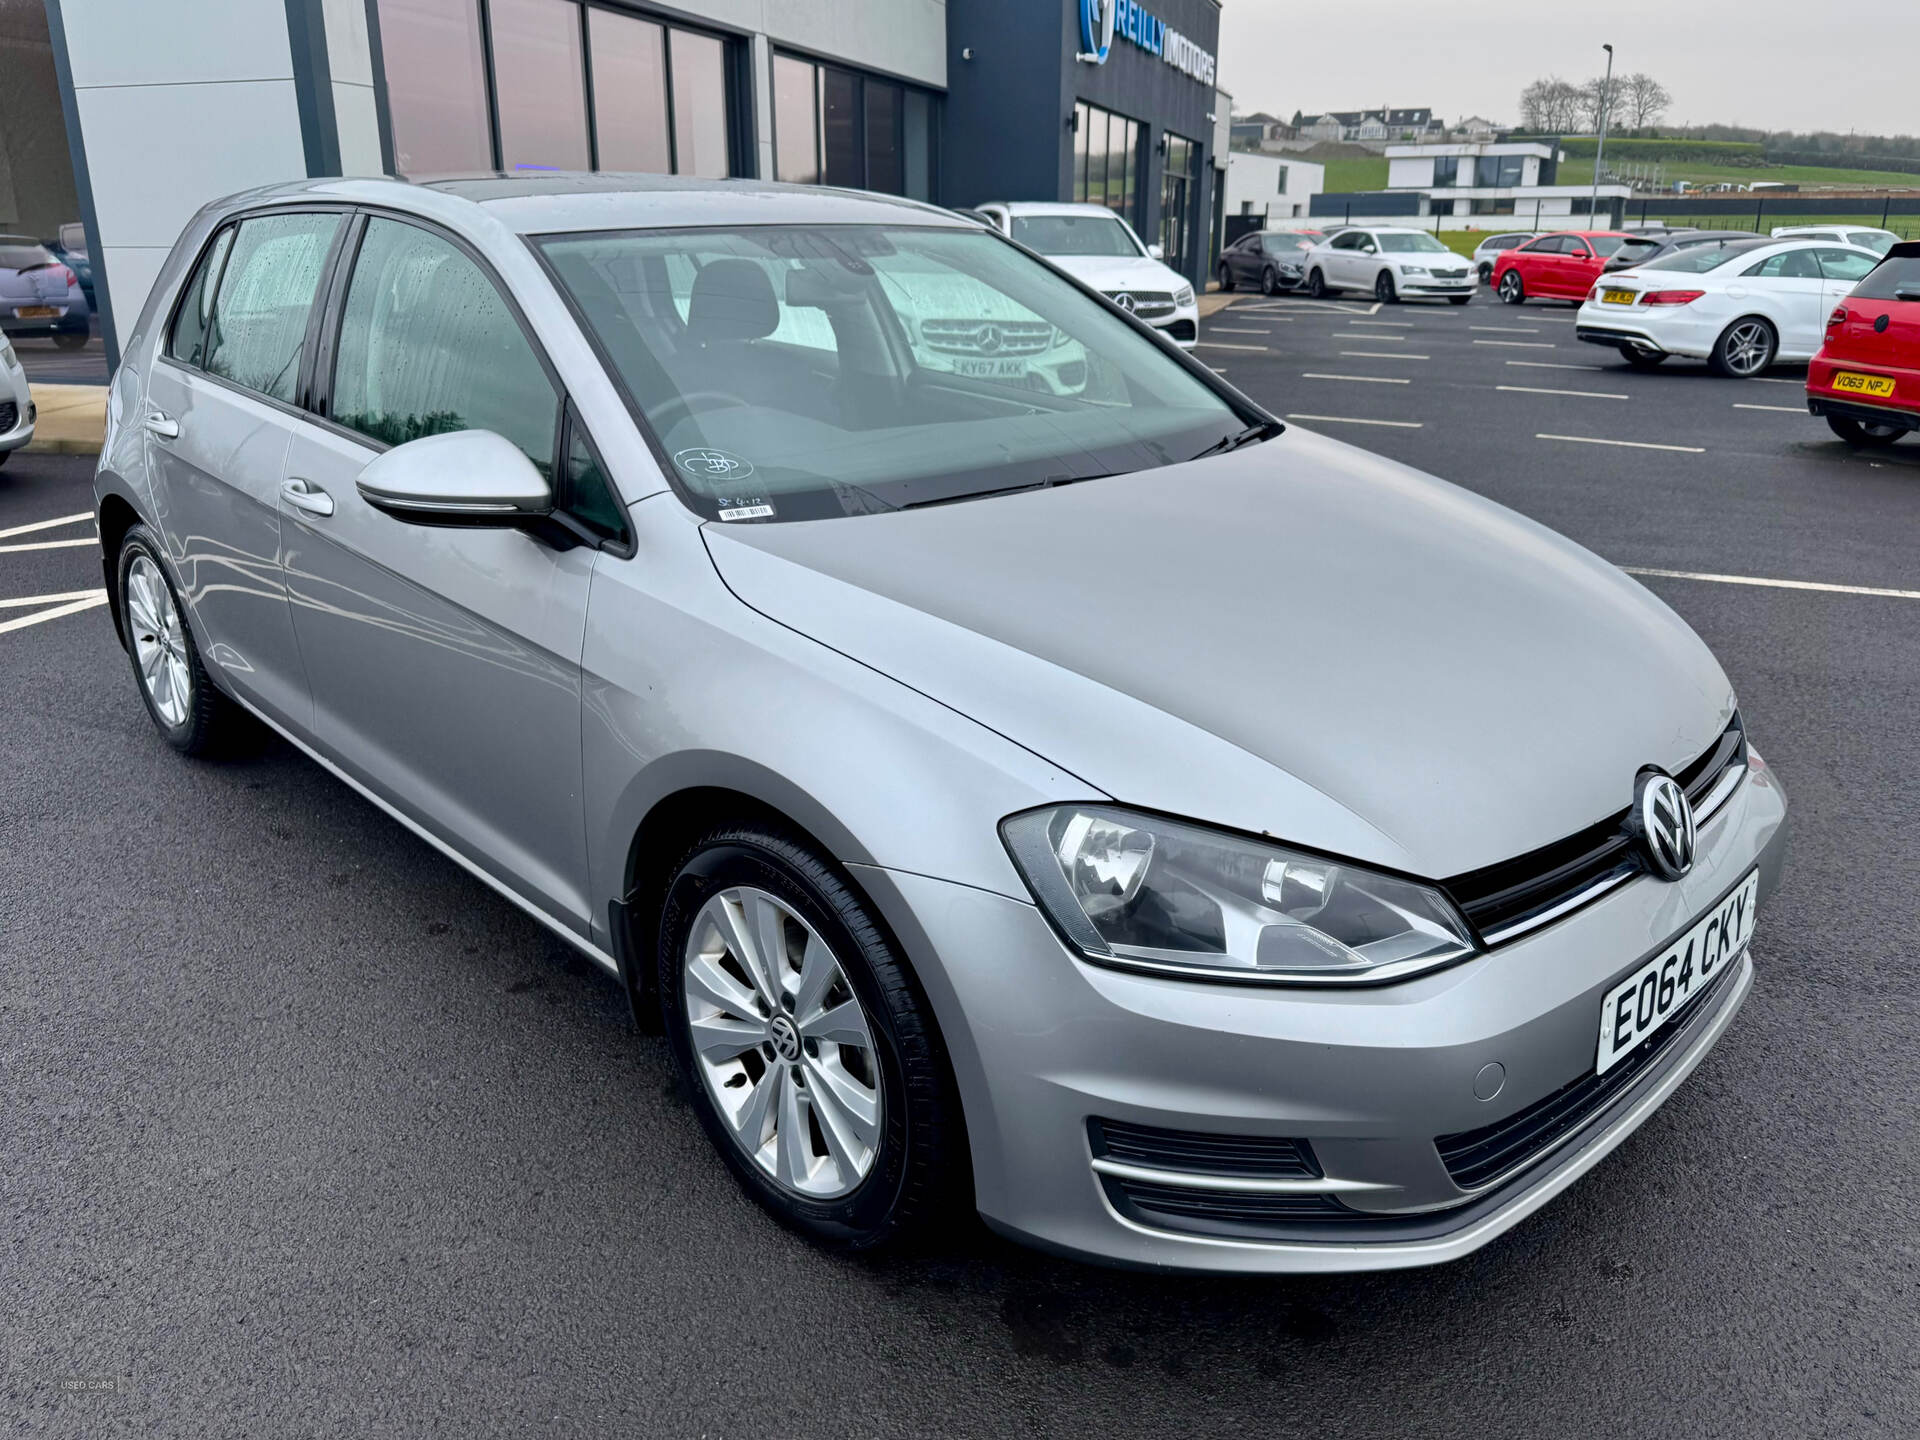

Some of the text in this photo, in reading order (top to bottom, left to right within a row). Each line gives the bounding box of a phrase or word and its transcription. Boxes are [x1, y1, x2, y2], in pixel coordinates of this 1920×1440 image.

[1115, 0, 1215, 86] REILLY MOTORS
[960, 360, 994, 374] KY67
[1837, 376, 1892, 393] VO63 NPJ
[1613, 938, 1695, 1054] EO64
[1701, 885, 1750, 976] CKY
